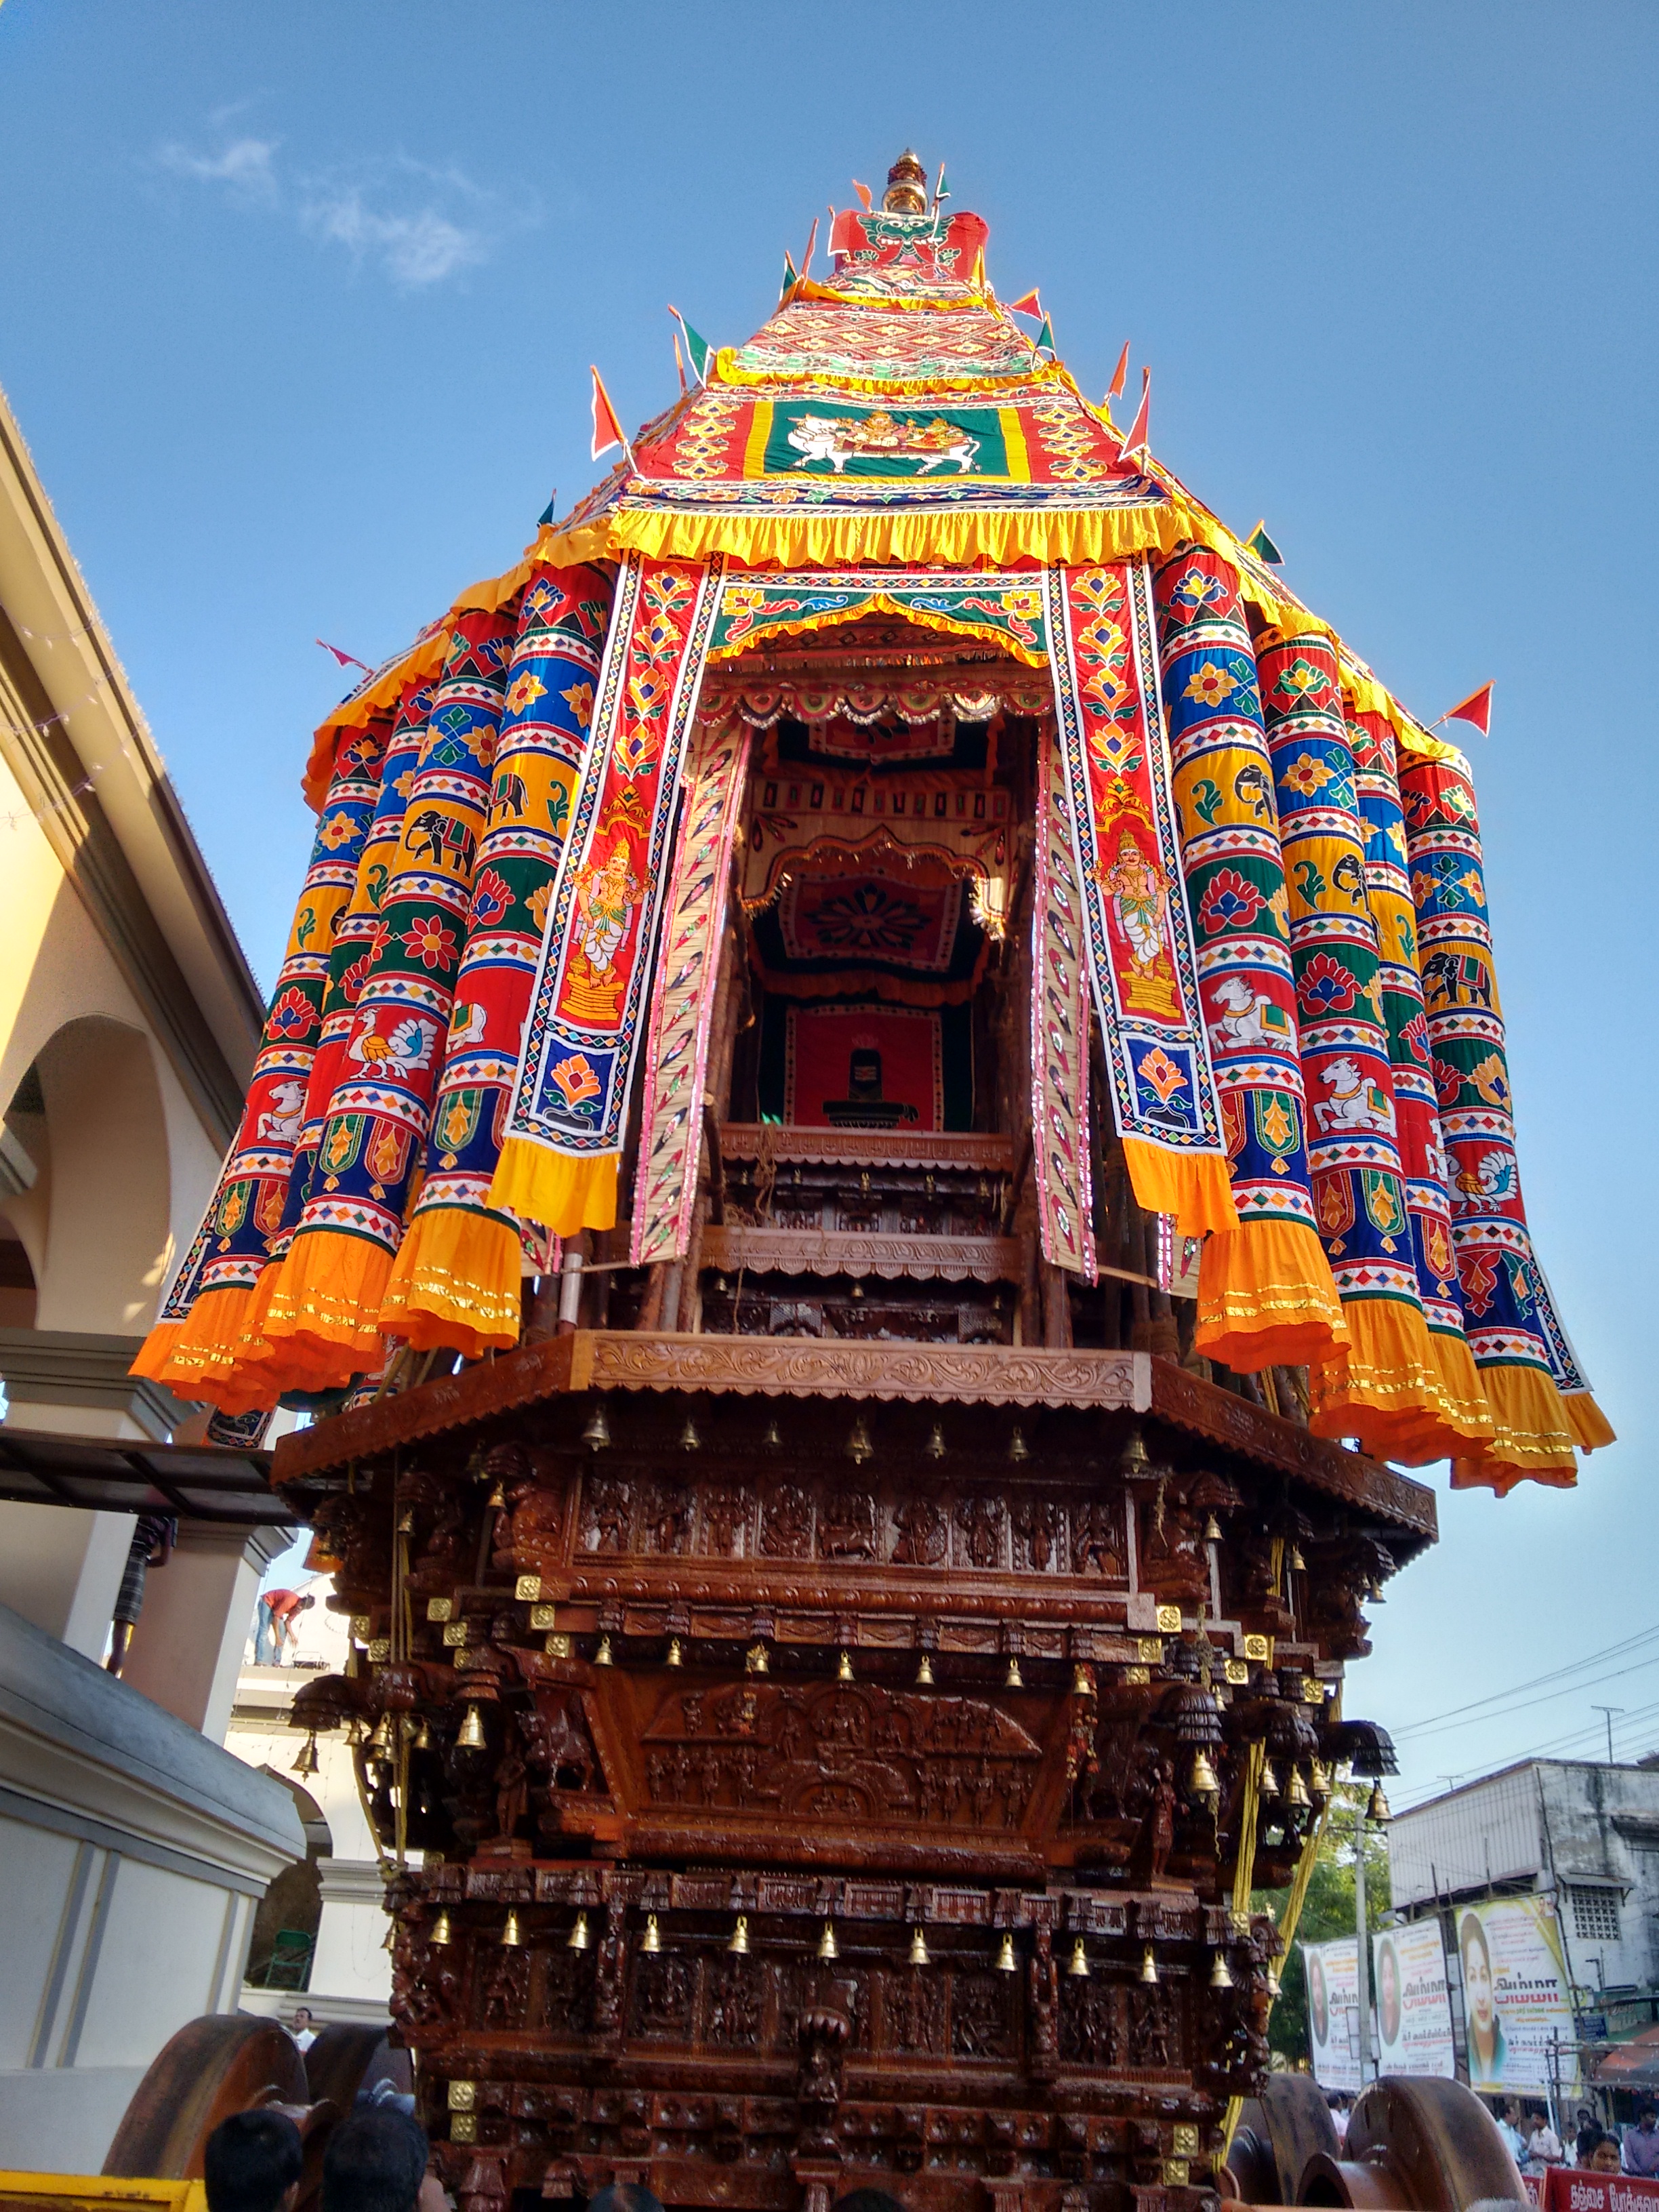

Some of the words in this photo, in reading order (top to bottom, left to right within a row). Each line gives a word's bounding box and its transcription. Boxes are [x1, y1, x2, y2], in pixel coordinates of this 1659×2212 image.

[1403, 1977, 1446, 2010] அம்மா
[1494, 1972, 1559, 2004] அம்மா
[1570, 2179, 1604, 2212] தஞ்சை
